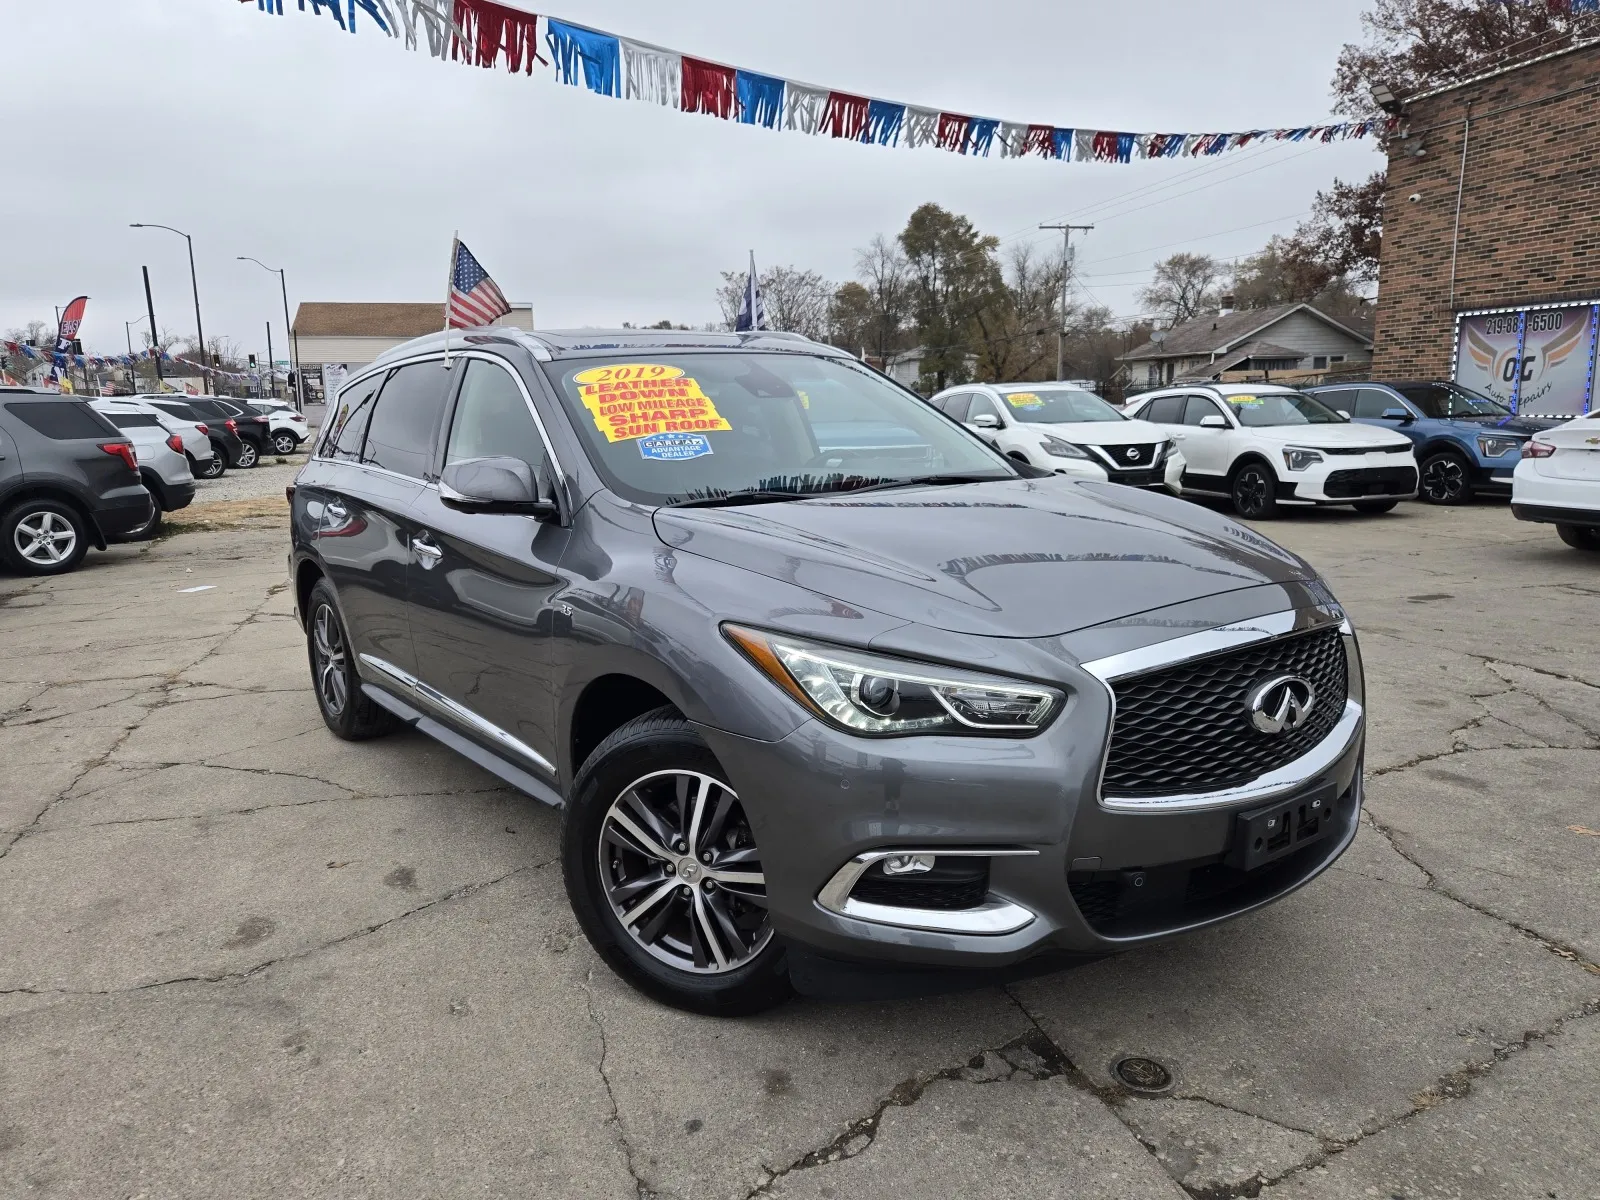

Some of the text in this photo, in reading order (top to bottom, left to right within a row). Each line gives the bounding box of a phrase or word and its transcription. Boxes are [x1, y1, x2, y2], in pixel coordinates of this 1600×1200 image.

[1486, 312, 1563, 335] 219-88-6500
[596, 366, 666, 382] 2019
[1503, 356, 1536, 382] OG
[585, 378, 692, 396] LEATHER
[1484, 383, 1506, 403] Auto
[599, 397, 707, 417] LOW MILEAGE
[608, 408, 708, 427] SHARP
[613, 419, 722, 439] SUN ROOF
[644, 438, 704, 448] CARFAX
[651, 445, 702, 454] ADVANTAGE
[661, 450, 695, 458] DEALER
